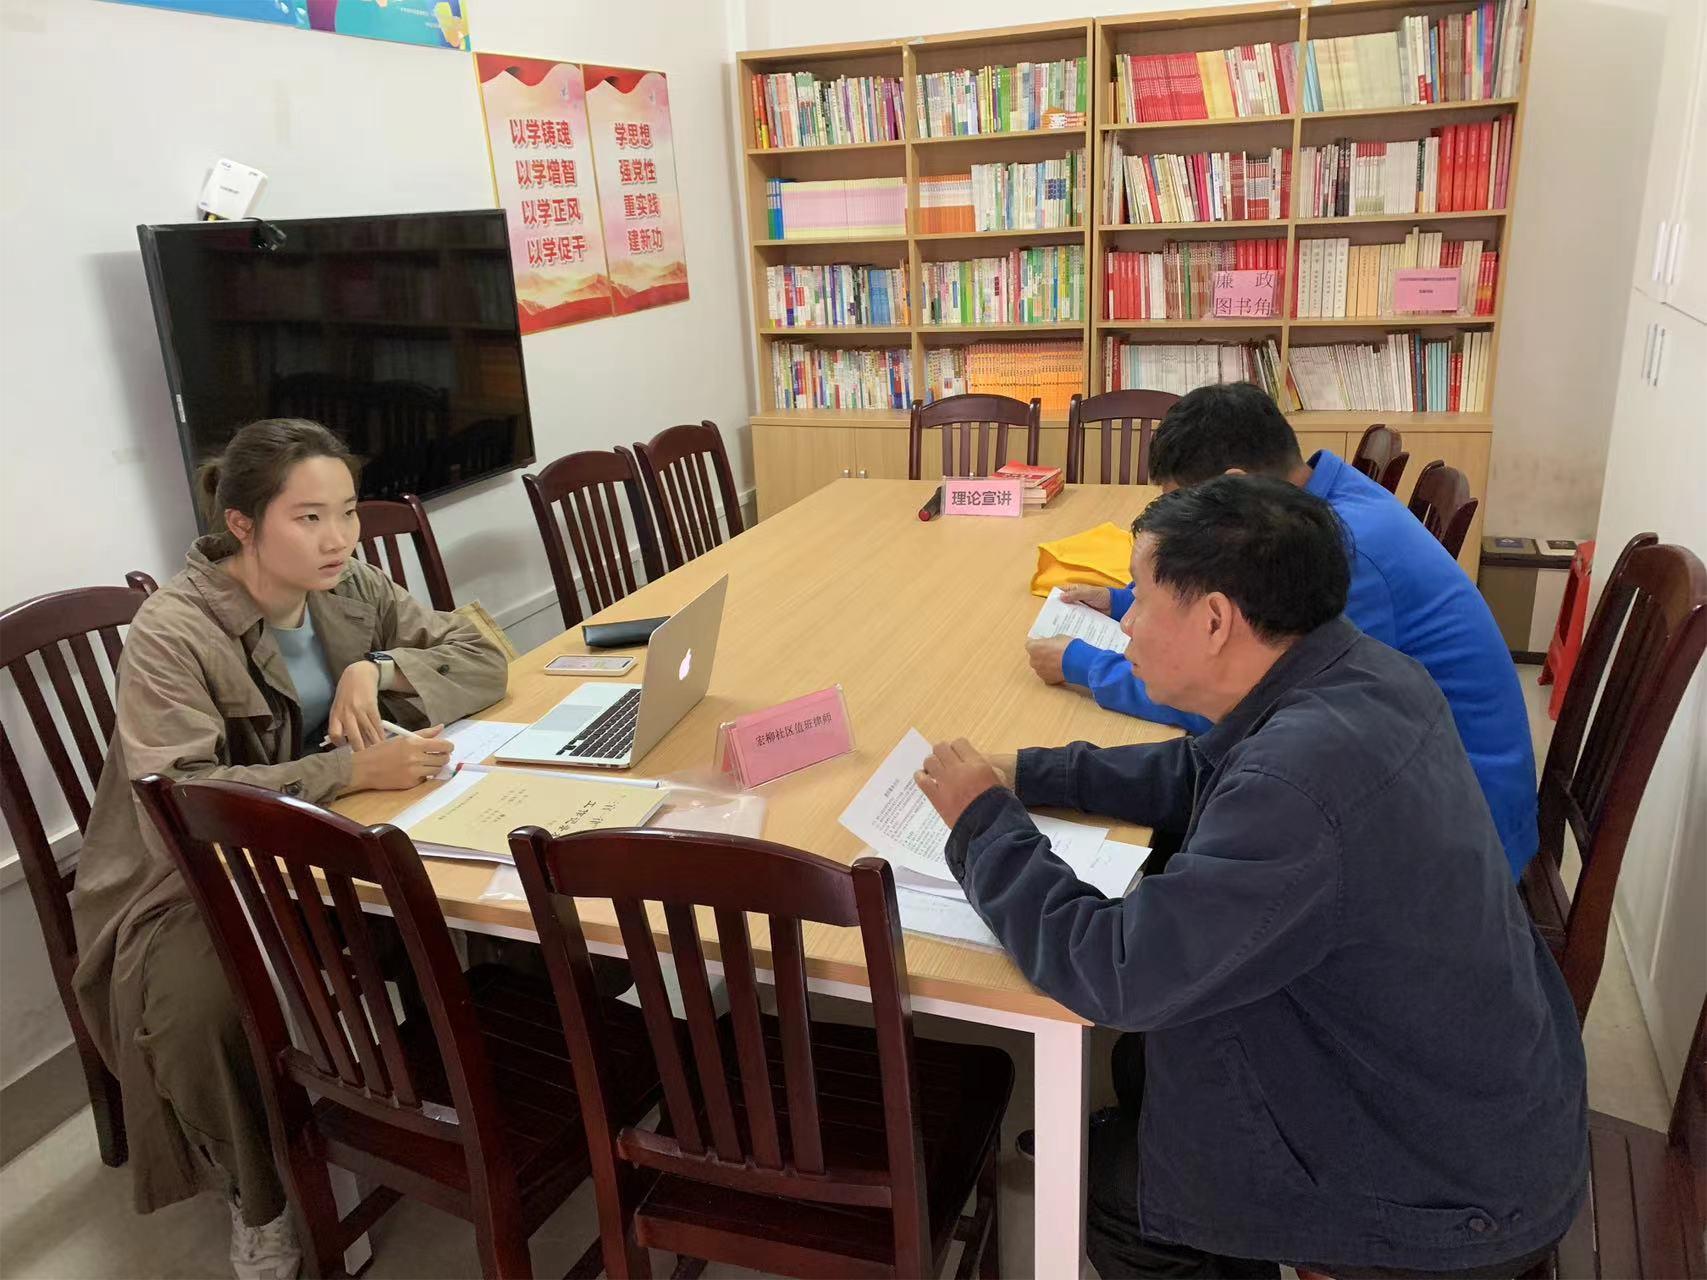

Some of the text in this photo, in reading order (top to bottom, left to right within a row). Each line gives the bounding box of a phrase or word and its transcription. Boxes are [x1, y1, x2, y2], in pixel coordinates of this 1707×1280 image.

[509, 119, 573, 147] 以学铸魂
[614, 123, 652, 148] 学思想
[515, 159, 577, 187] 以学增智
[618, 159, 656, 183] 强党性
[521, 197, 582, 226] 以学正风
[623, 193, 660, 218] 重实践
[527, 235, 586, 265] 以学促干
[627, 228, 663, 253] 建新功
[1215, 297, 1271, 316] 图书角
[951, 490, 1012, 506] 理论宣讲
[755, 711, 833, 747] 宏柳社区值班律师
